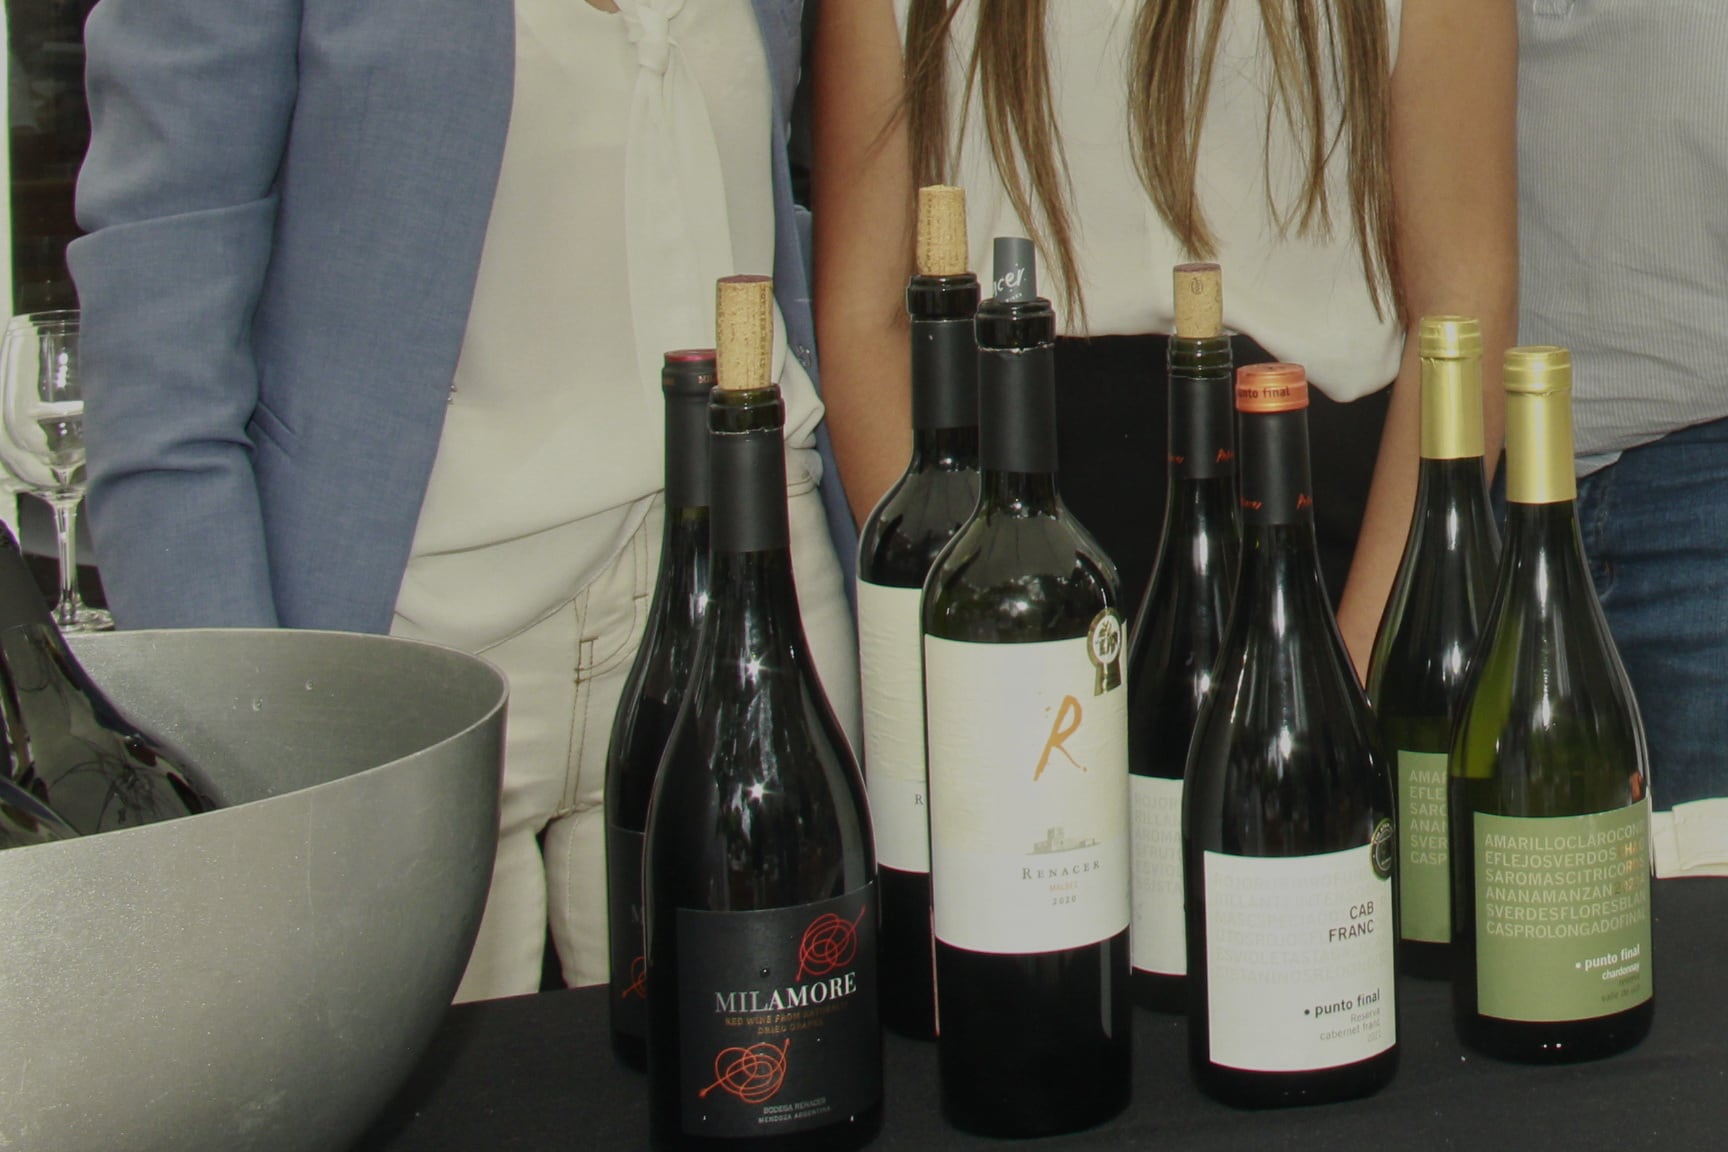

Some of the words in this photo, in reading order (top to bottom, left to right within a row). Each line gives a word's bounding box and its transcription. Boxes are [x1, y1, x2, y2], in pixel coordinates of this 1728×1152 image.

[1262, 386, 1290, 399] final
[1033, 694, 1087, 782] R
[1349, 900, 1375, 921] CAB
[1328, 920, 1376, 944] FRANC
[1583, 953, 1618, 973] punto
[1620, 943, 1641, 961] final
[714, 971, 857, 1014] MILAMORE
[1314, 999, 1354, 1019] punto
[1356, 986, 1381, 1007] final
